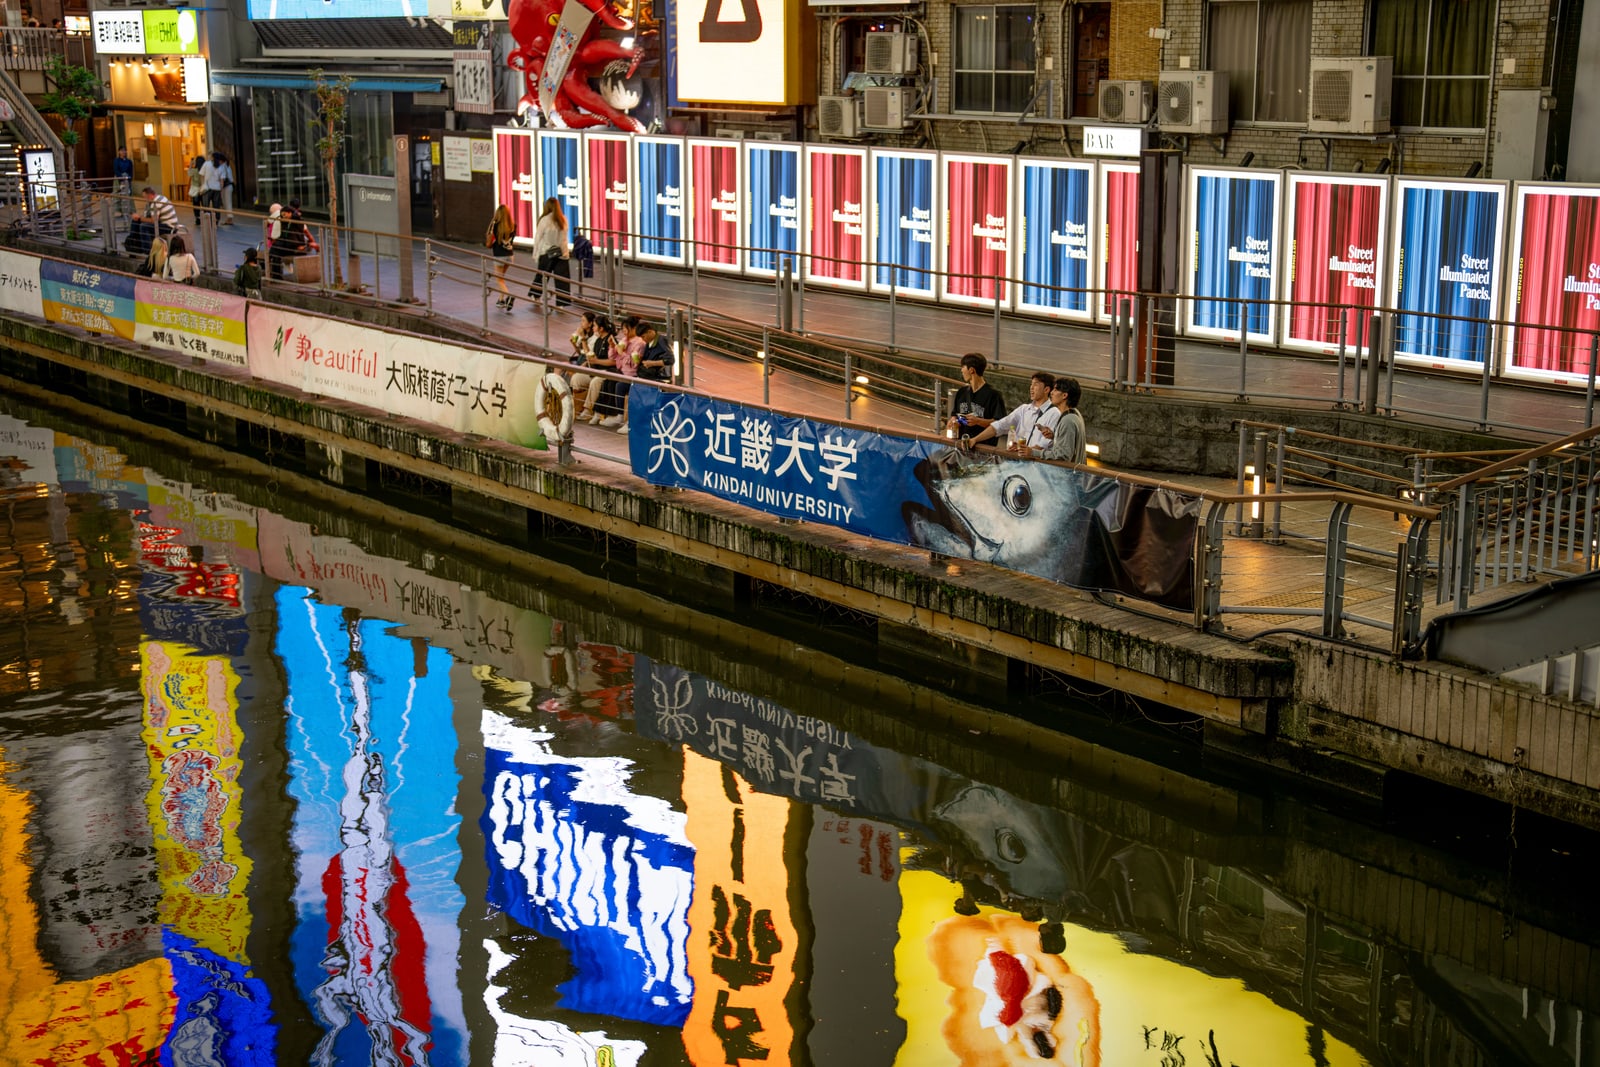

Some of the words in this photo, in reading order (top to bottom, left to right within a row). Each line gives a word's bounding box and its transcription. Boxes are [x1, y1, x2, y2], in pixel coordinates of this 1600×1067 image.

[1086, 133, 1114, 149] BAR
[366, 192, 392, 201] information
[1246, 236, 1269, 251] Street
[1348, 244, 1373, 260] Street
[1461, 253, 1489, 270] Street
[1347, 273, 1376, 289] Panels.
[1459, 283, 1491, 300] Panels.
[703, 409, 858, 492] 近畿大学
[703, 470, 754, 499] KINDAI
[756, 484, 853, 524] UNIVERSITY
